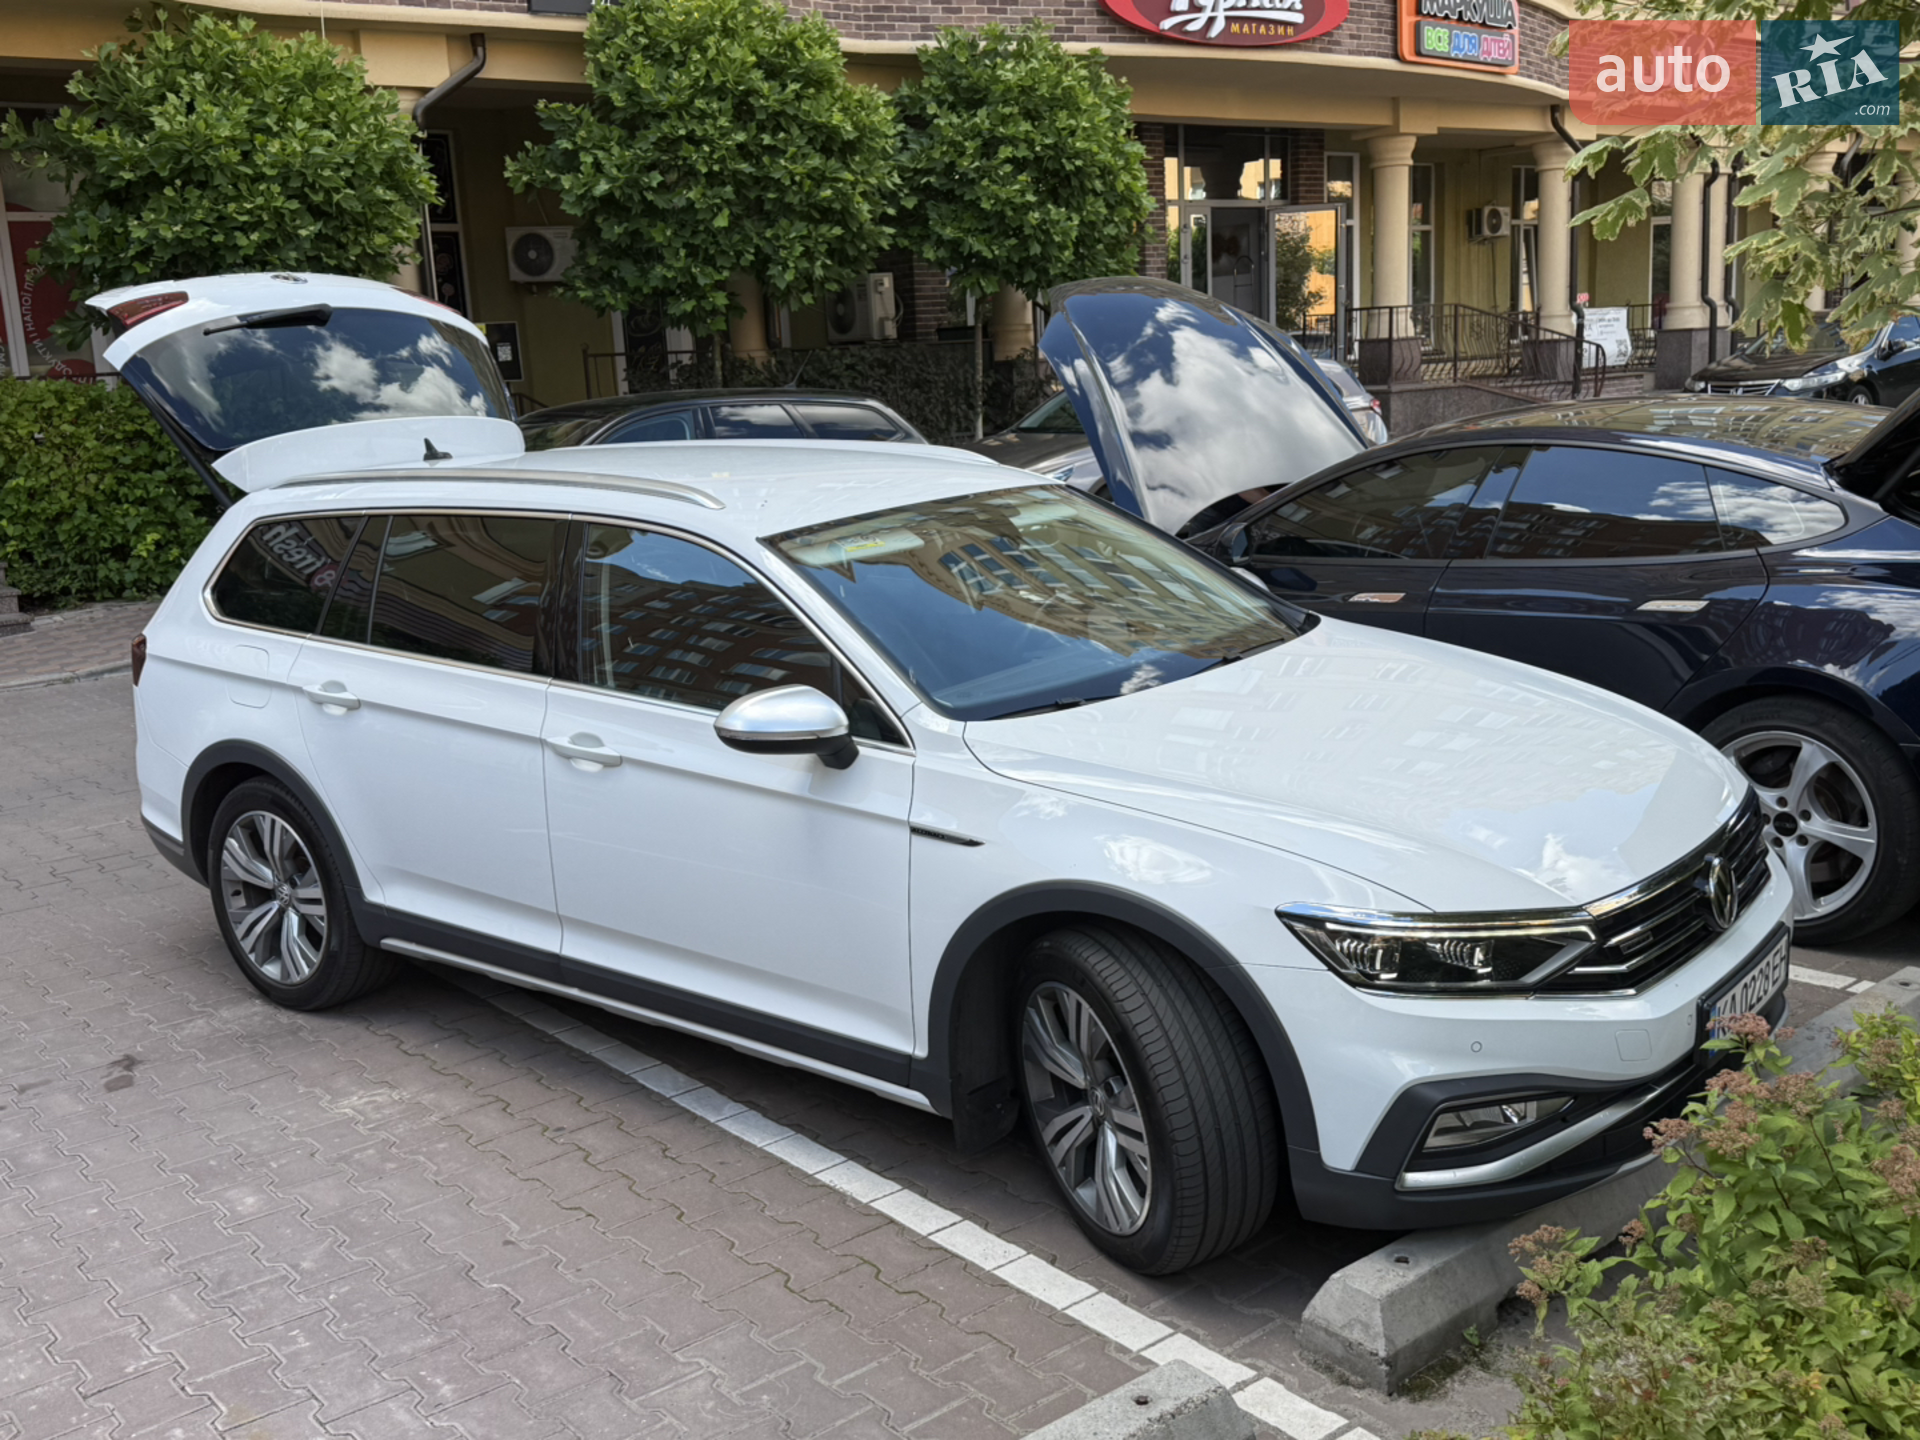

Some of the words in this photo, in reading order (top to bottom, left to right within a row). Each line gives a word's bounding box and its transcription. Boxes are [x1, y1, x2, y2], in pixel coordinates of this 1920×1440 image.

[1230, 22, 1295, 37] МАГАЗИН
[1424, 26, 1449, 52] ВСЕ
[1450, 30, 1478, 57] ДЛЯ
[1740, 960, 1771, 1016] 0228
